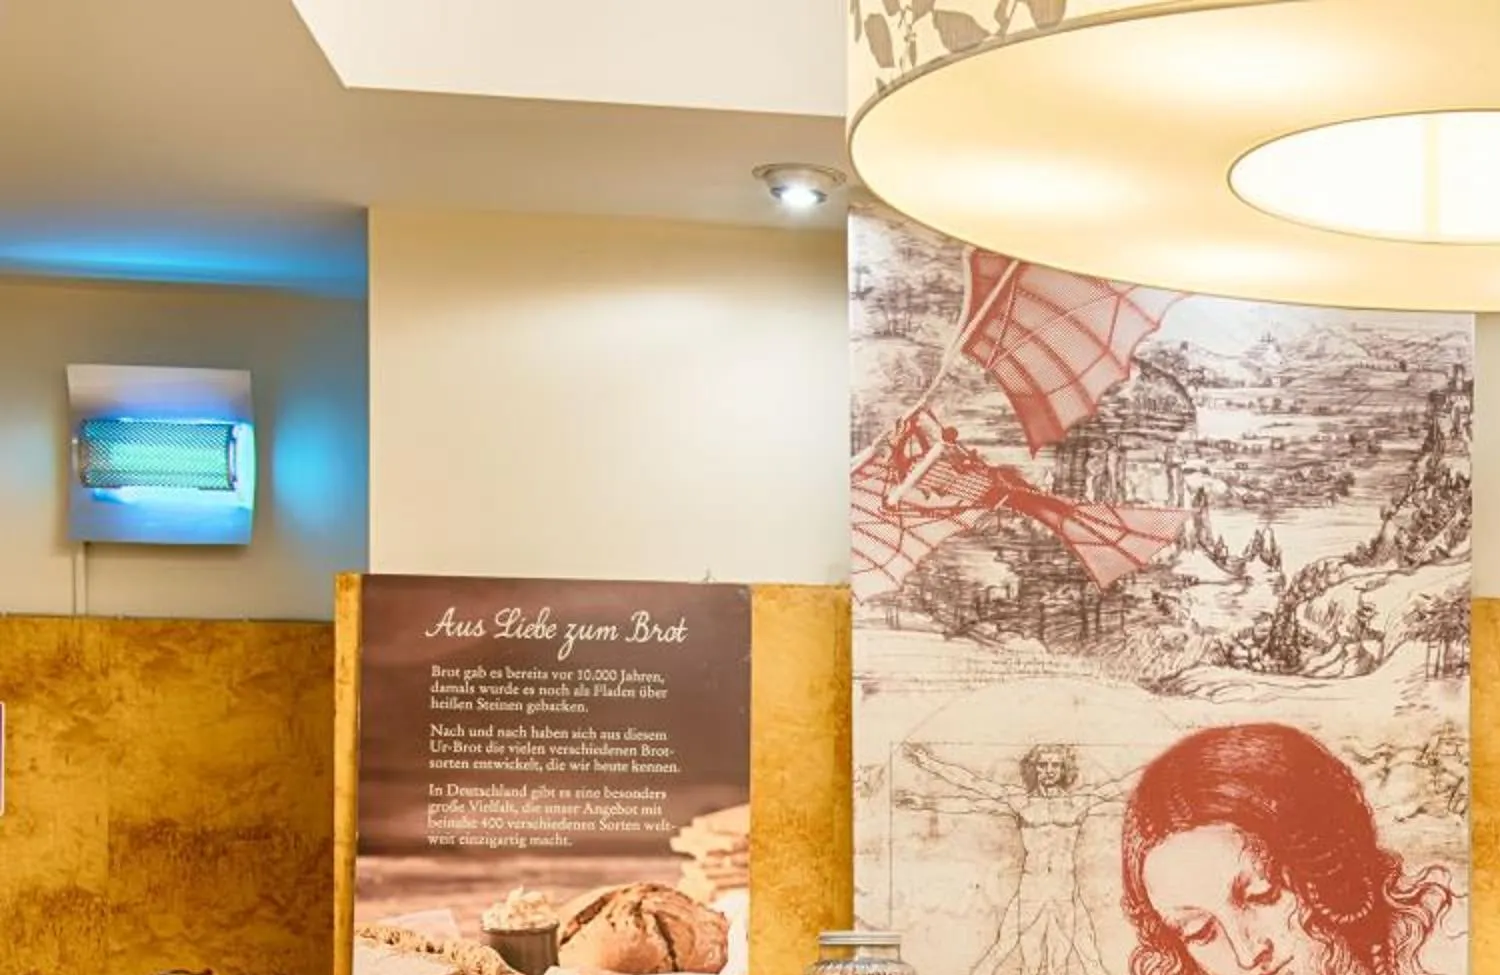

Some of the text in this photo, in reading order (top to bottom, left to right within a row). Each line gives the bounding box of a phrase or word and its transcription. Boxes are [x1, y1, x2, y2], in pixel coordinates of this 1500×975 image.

[425, 606, 689, 661] Aus Liebe zum Brot
[431, 665, 665, 685] Brot gab es bereits vor 10.000 Jahren,
[431, 680, 668, 699] damals wurde es noch als Fladen über
[431, 696, 589, 714] heißen Steinen gebacken.
[430, 723, 668, 740] Nach und nach haben sich aus diesem
[429, 739, 675, 757] Ur-Brot die vielen verschiedenen Brot-
[429, 757, 681, 773] sorten entwickelt, die wir heute kennen.
